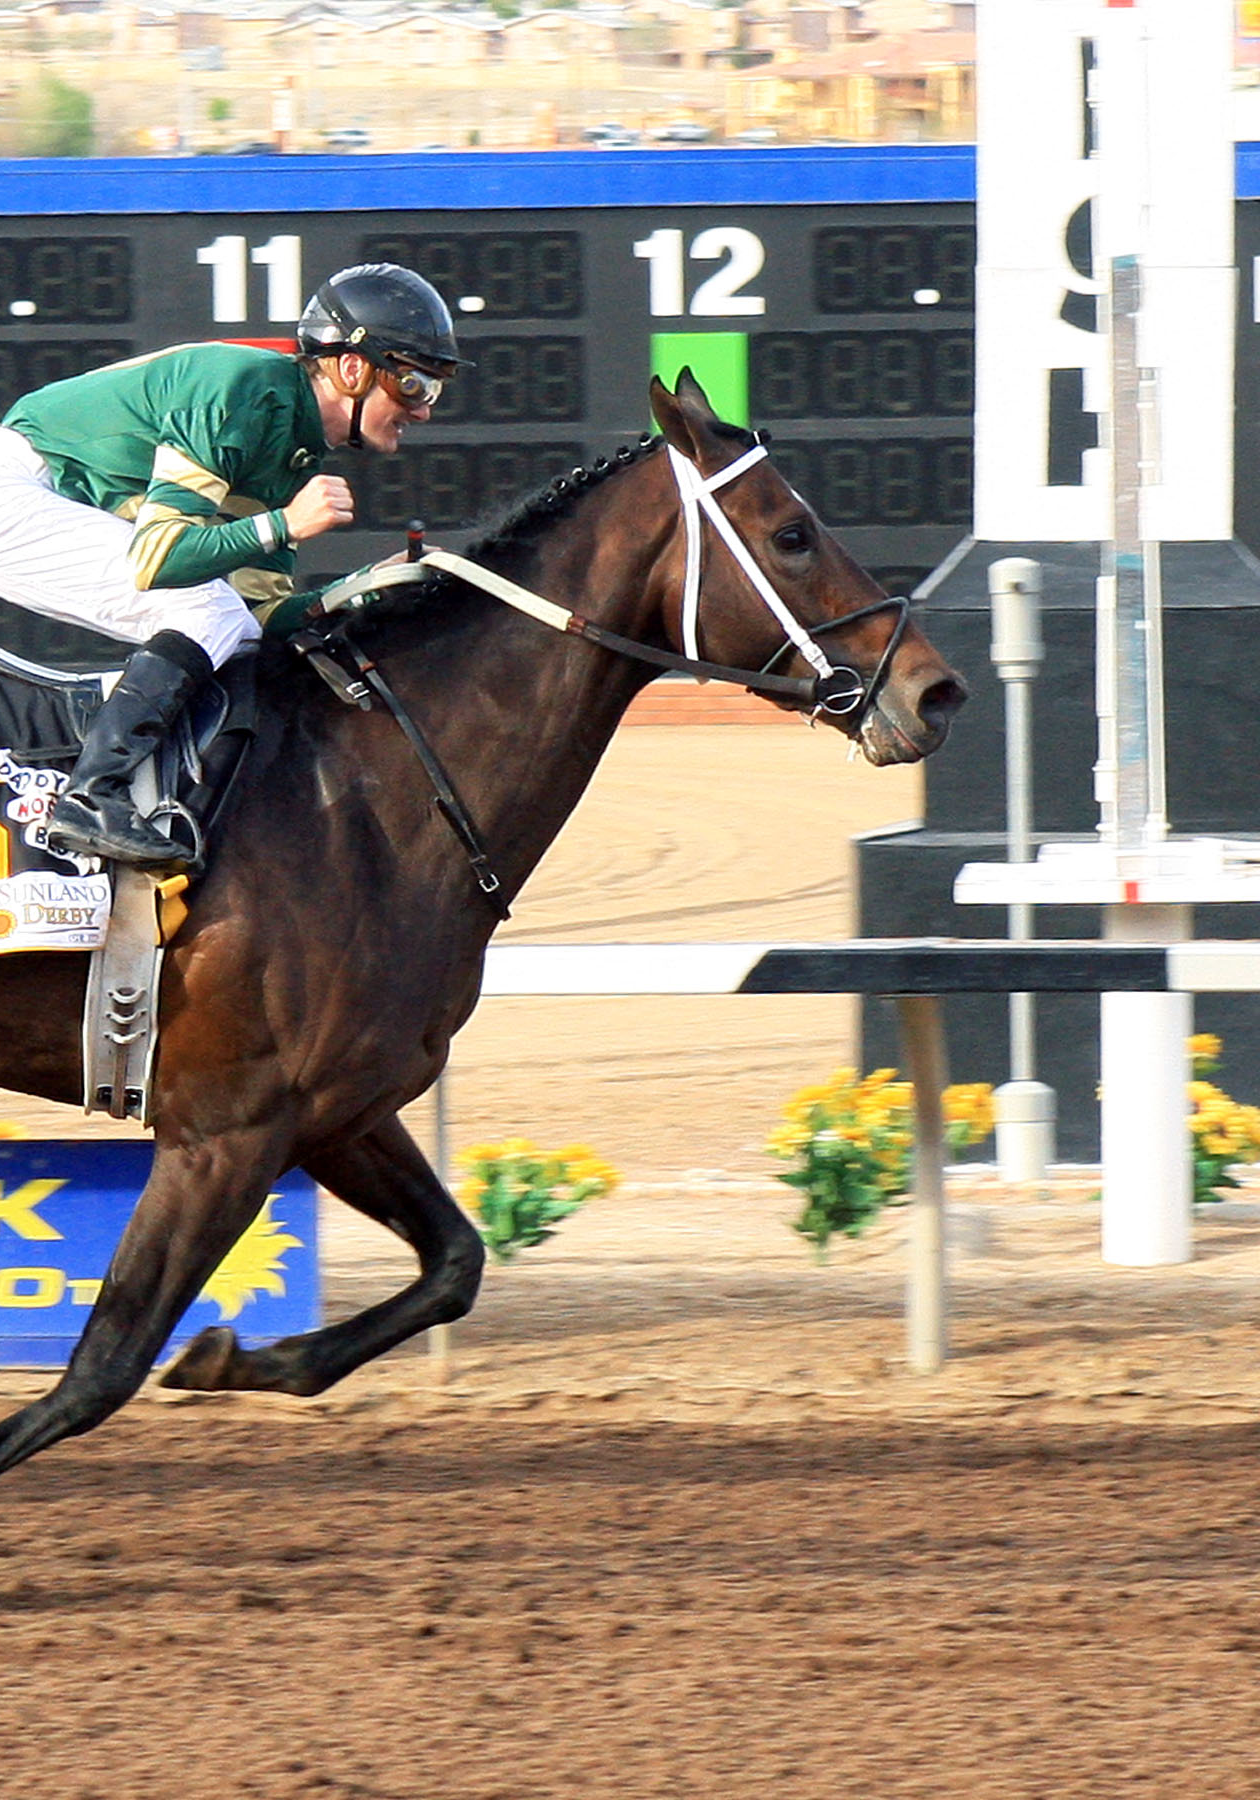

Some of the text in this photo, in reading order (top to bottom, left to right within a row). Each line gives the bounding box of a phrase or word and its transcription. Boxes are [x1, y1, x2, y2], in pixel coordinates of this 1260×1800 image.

[197, 234, 302, 323] 11
[633, 227, 766, 317] 12
[22, 903, 97, 925] DERBY
